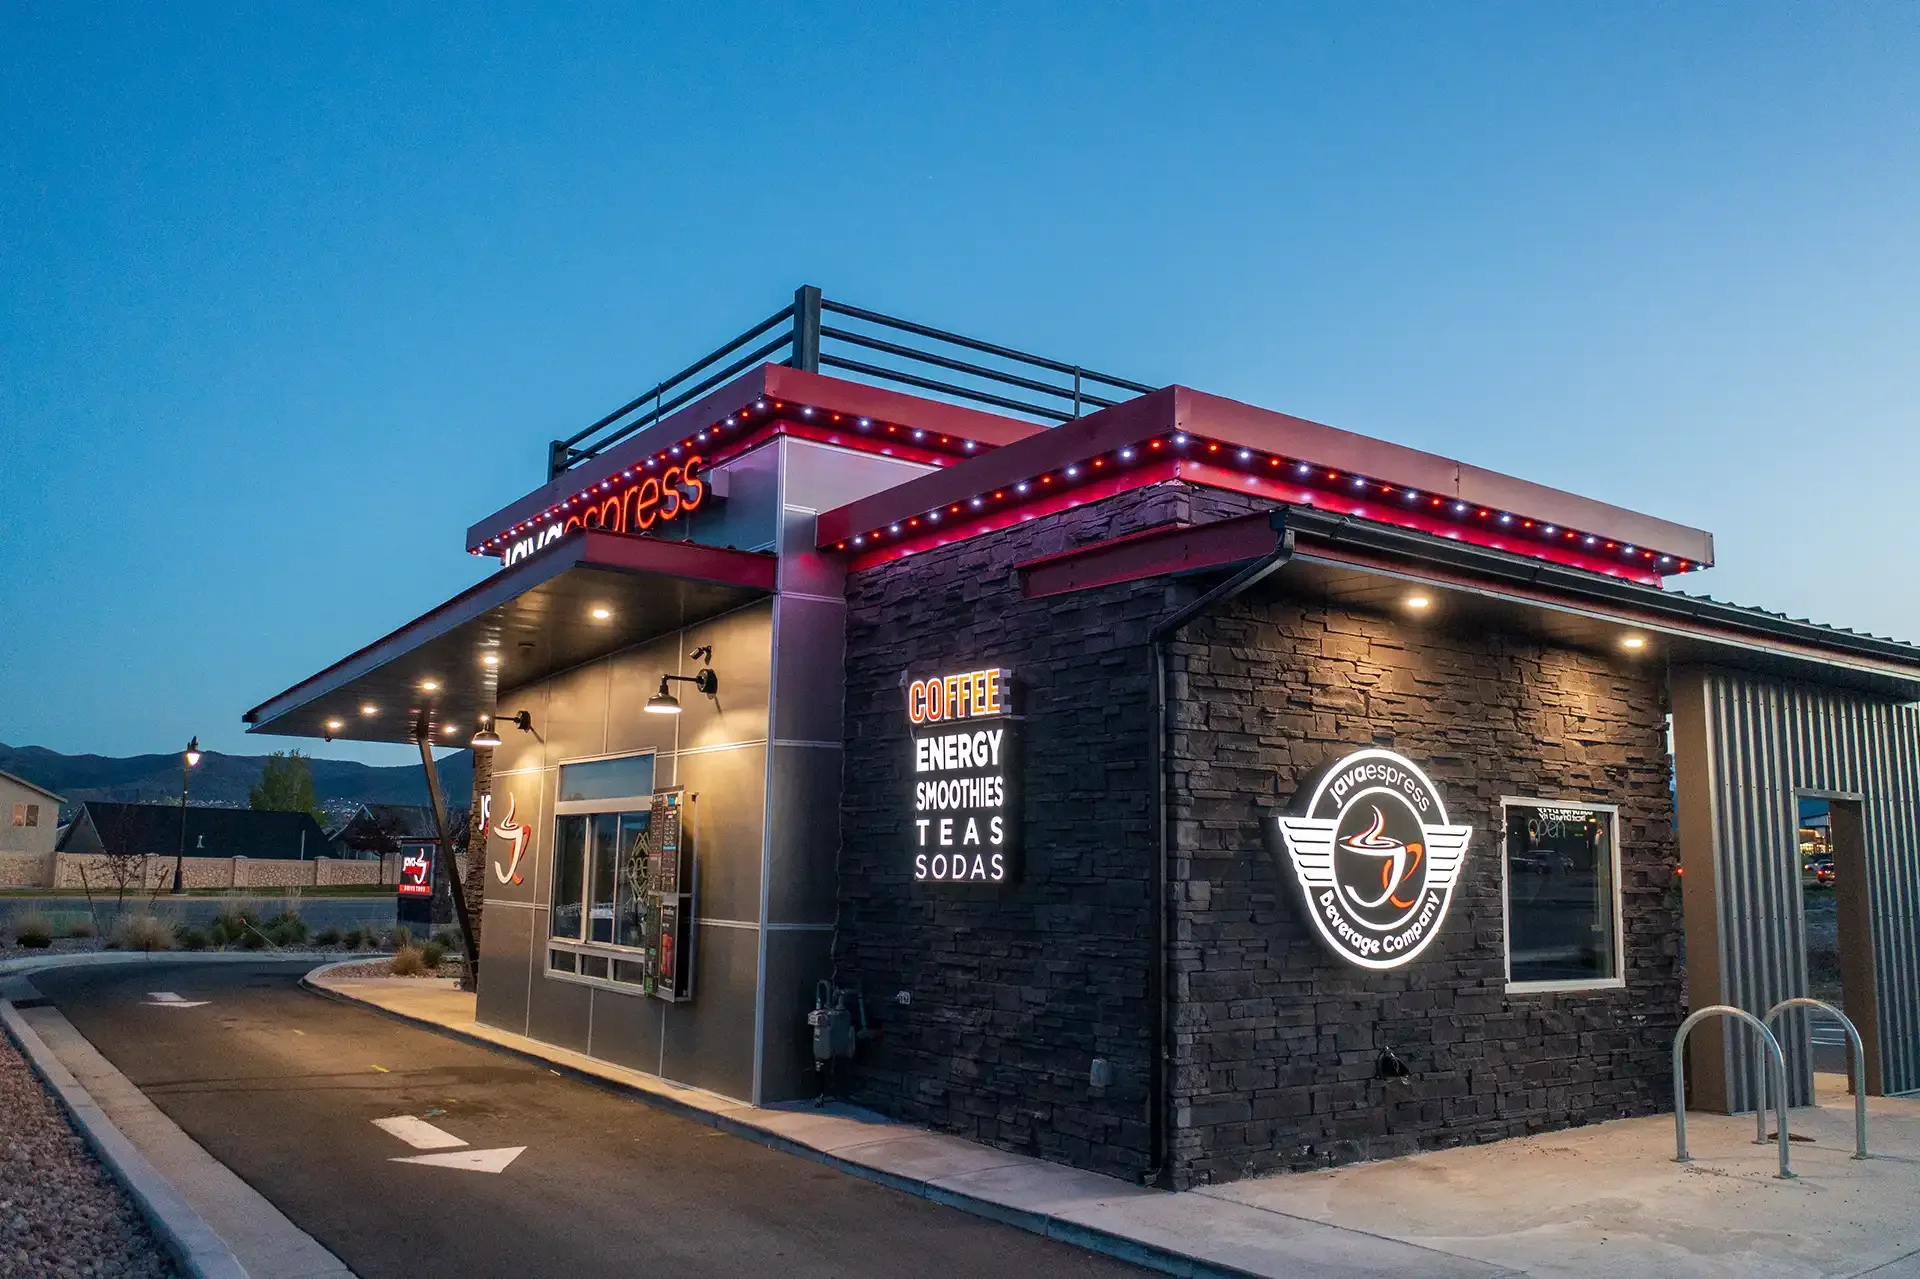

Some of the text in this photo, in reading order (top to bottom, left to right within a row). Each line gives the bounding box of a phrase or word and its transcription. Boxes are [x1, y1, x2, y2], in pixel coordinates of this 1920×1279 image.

[909, 668, 1001, 724] COFFEE
[916, 729, 1004, 772] ENERGY
[916, 776, 1004, 811] SMOOTHIES
[1329, 764, 1430, 812] javaespress
[916, 816, 1004, 846] TEAS
[1528, 818, 1566, 843] open
[915, 854, 1004, 880] SODAS
[1382, 890, 1440, 953] Company
